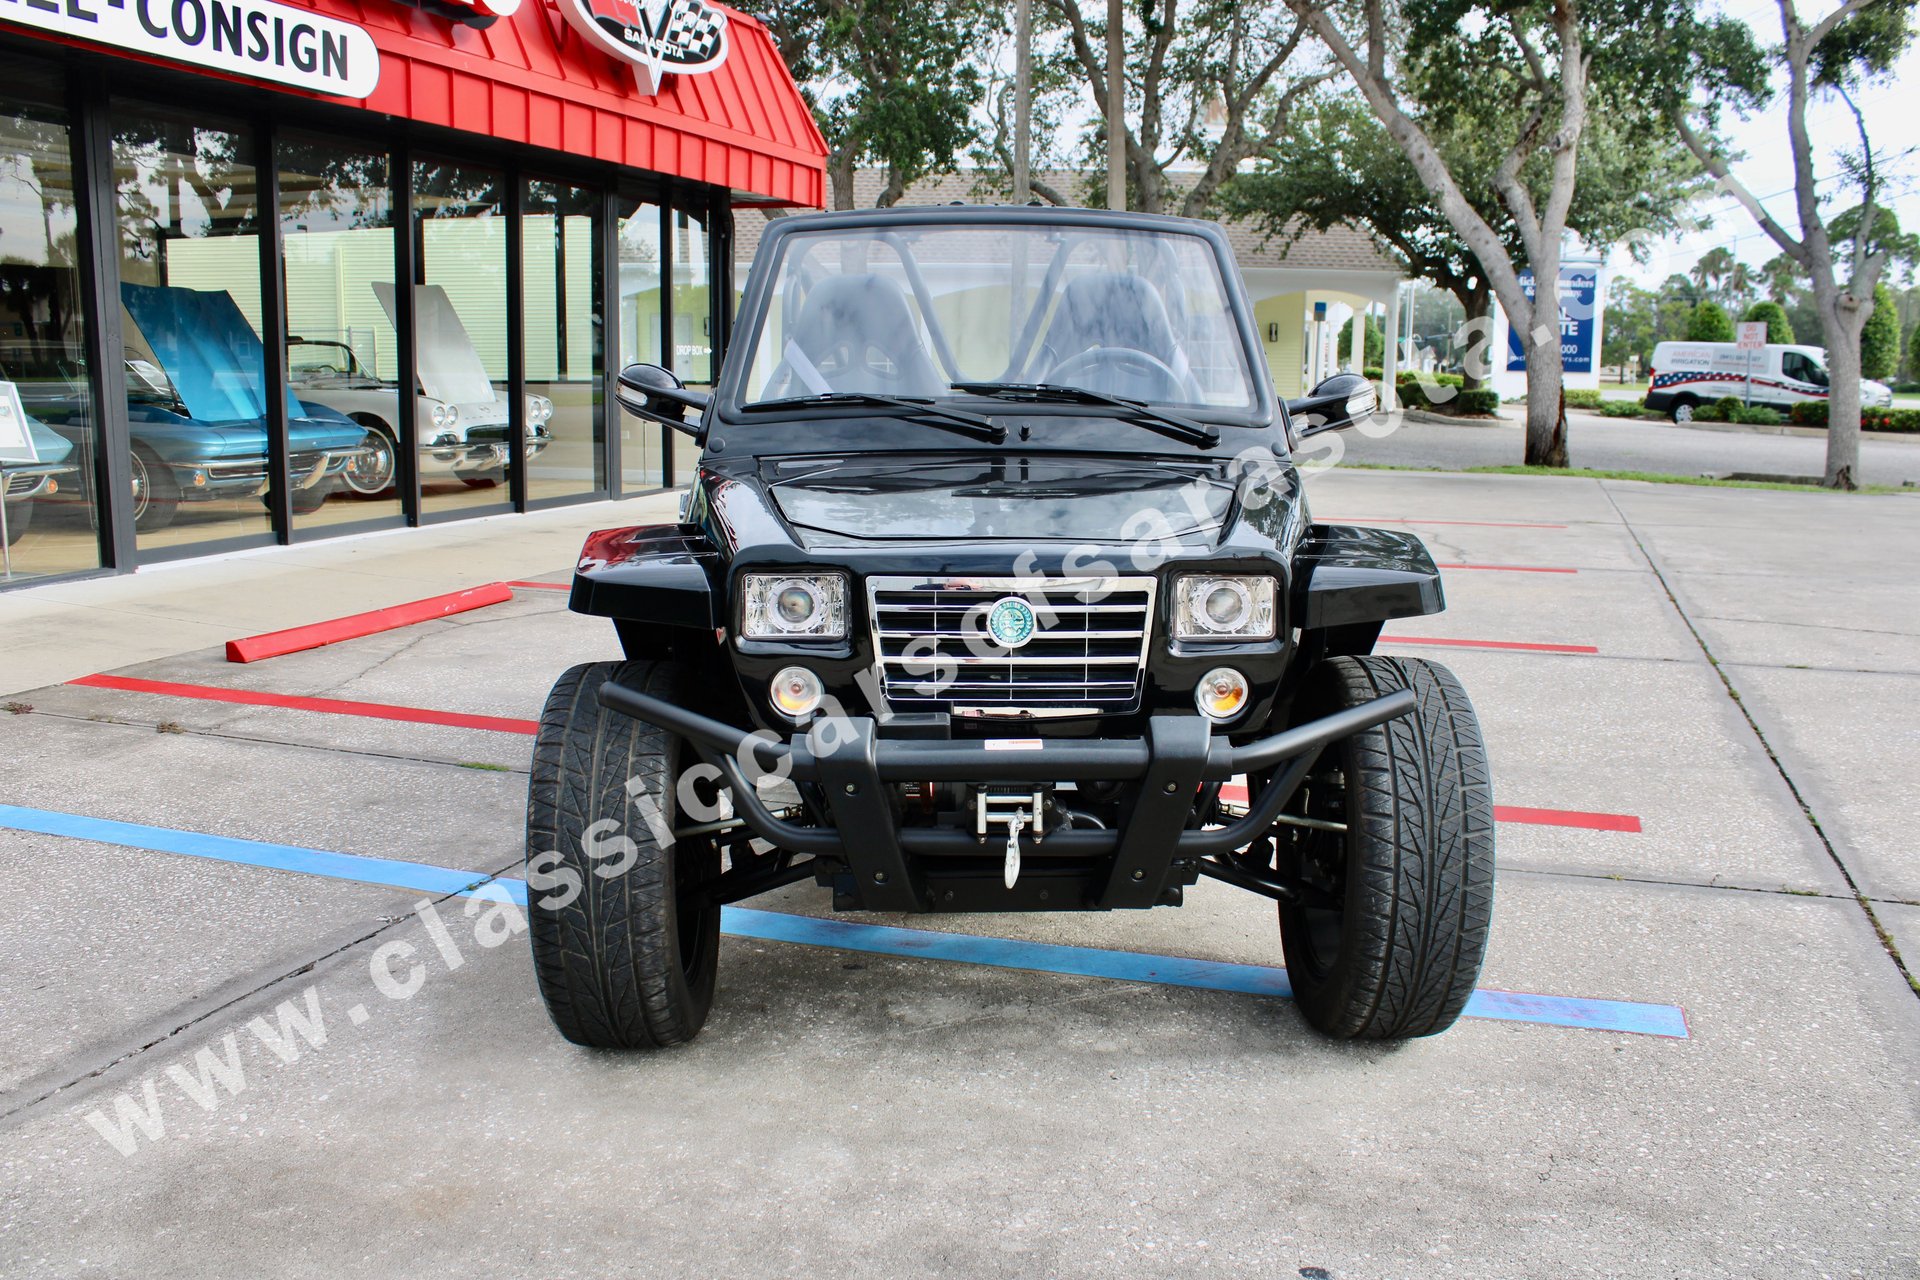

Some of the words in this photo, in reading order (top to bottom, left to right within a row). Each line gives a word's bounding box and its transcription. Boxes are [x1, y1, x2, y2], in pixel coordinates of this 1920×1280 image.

[136, 0, 348, 81] CONSIGN
[624, 27, 685, 60] SARASOTA
[676, 345, 691, 356] DROP
[692, 345, 703, 356] BOX
[1737, 342, 1763, 350] ENTER
